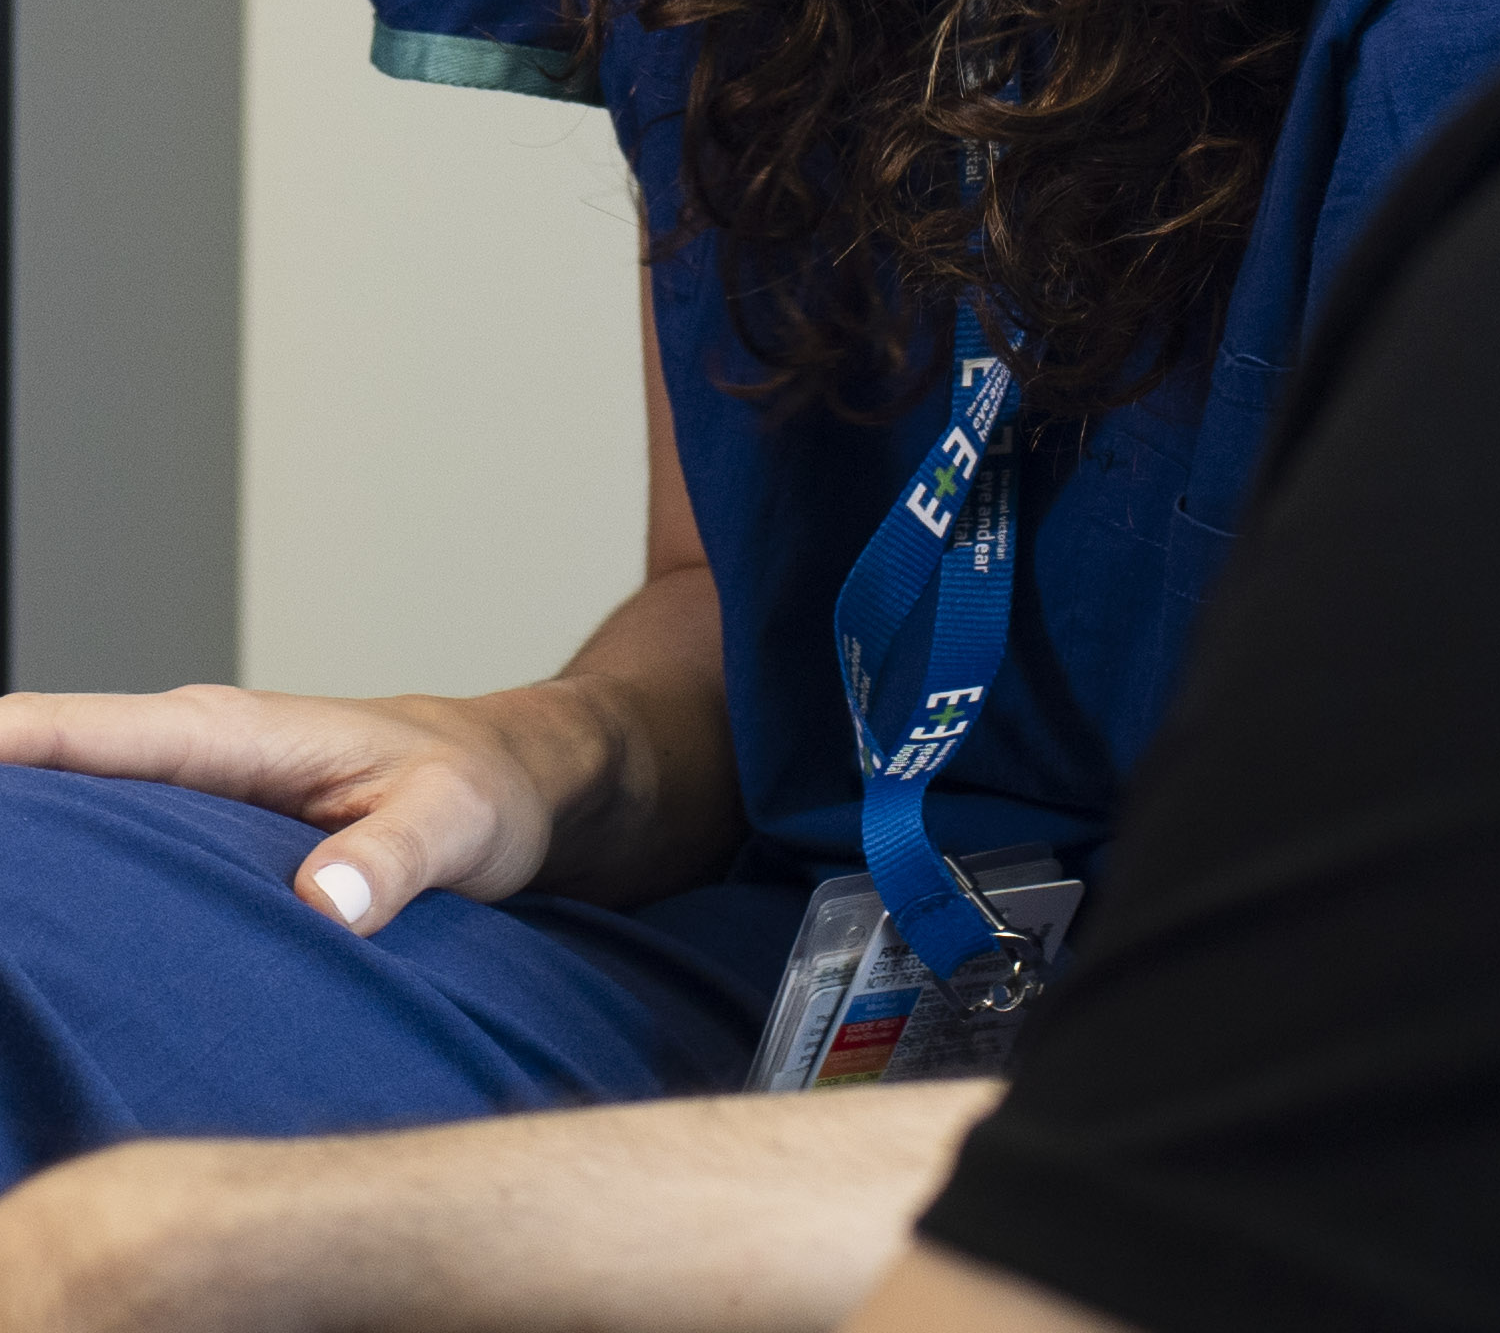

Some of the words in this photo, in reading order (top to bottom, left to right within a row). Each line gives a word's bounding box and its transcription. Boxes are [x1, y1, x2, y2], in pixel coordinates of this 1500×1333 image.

[971, 397, 992, 430] eye
[976, 471, 993, 503] eye
[975, 504, 995, 541] and
[996, 514, 1009, 560] victorian
[973, 541, 990, 573] ear
